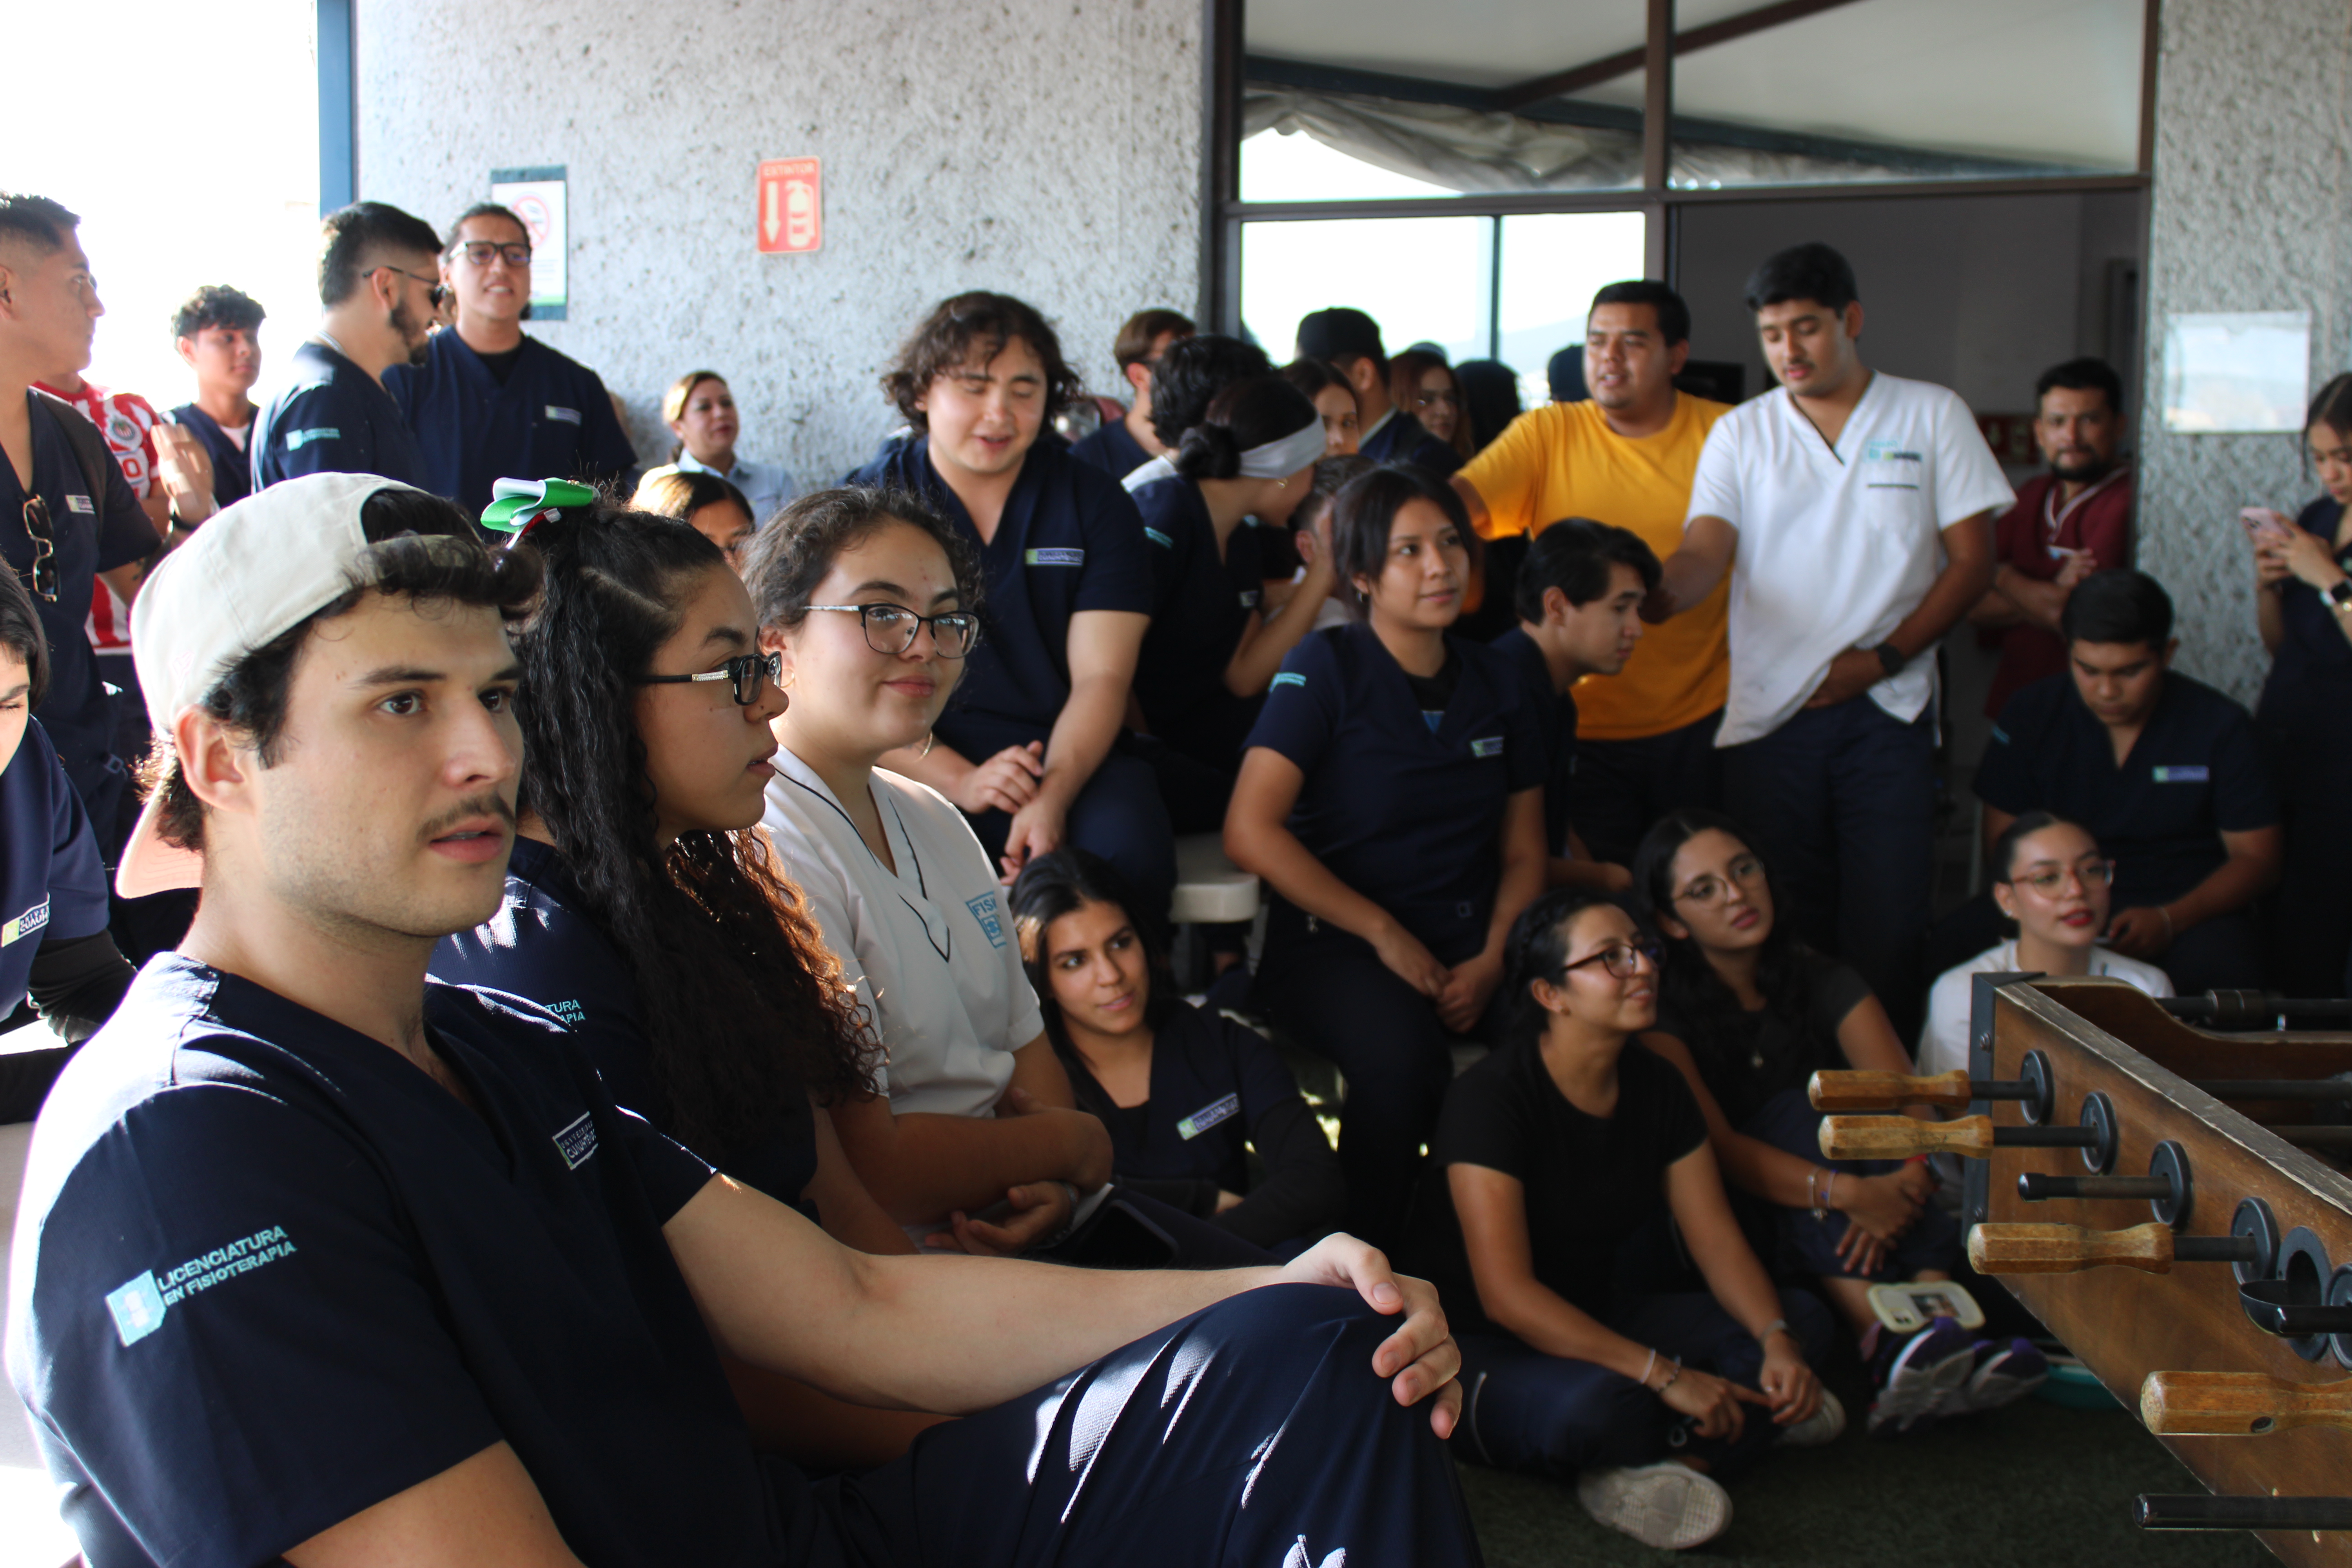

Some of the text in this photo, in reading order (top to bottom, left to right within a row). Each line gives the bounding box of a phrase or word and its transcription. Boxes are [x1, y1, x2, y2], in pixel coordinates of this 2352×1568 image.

[158, 1225, 288, 1292] LICENCIATURA
[163, 1241, 297, 1306] EN FISIOTERAPIA
